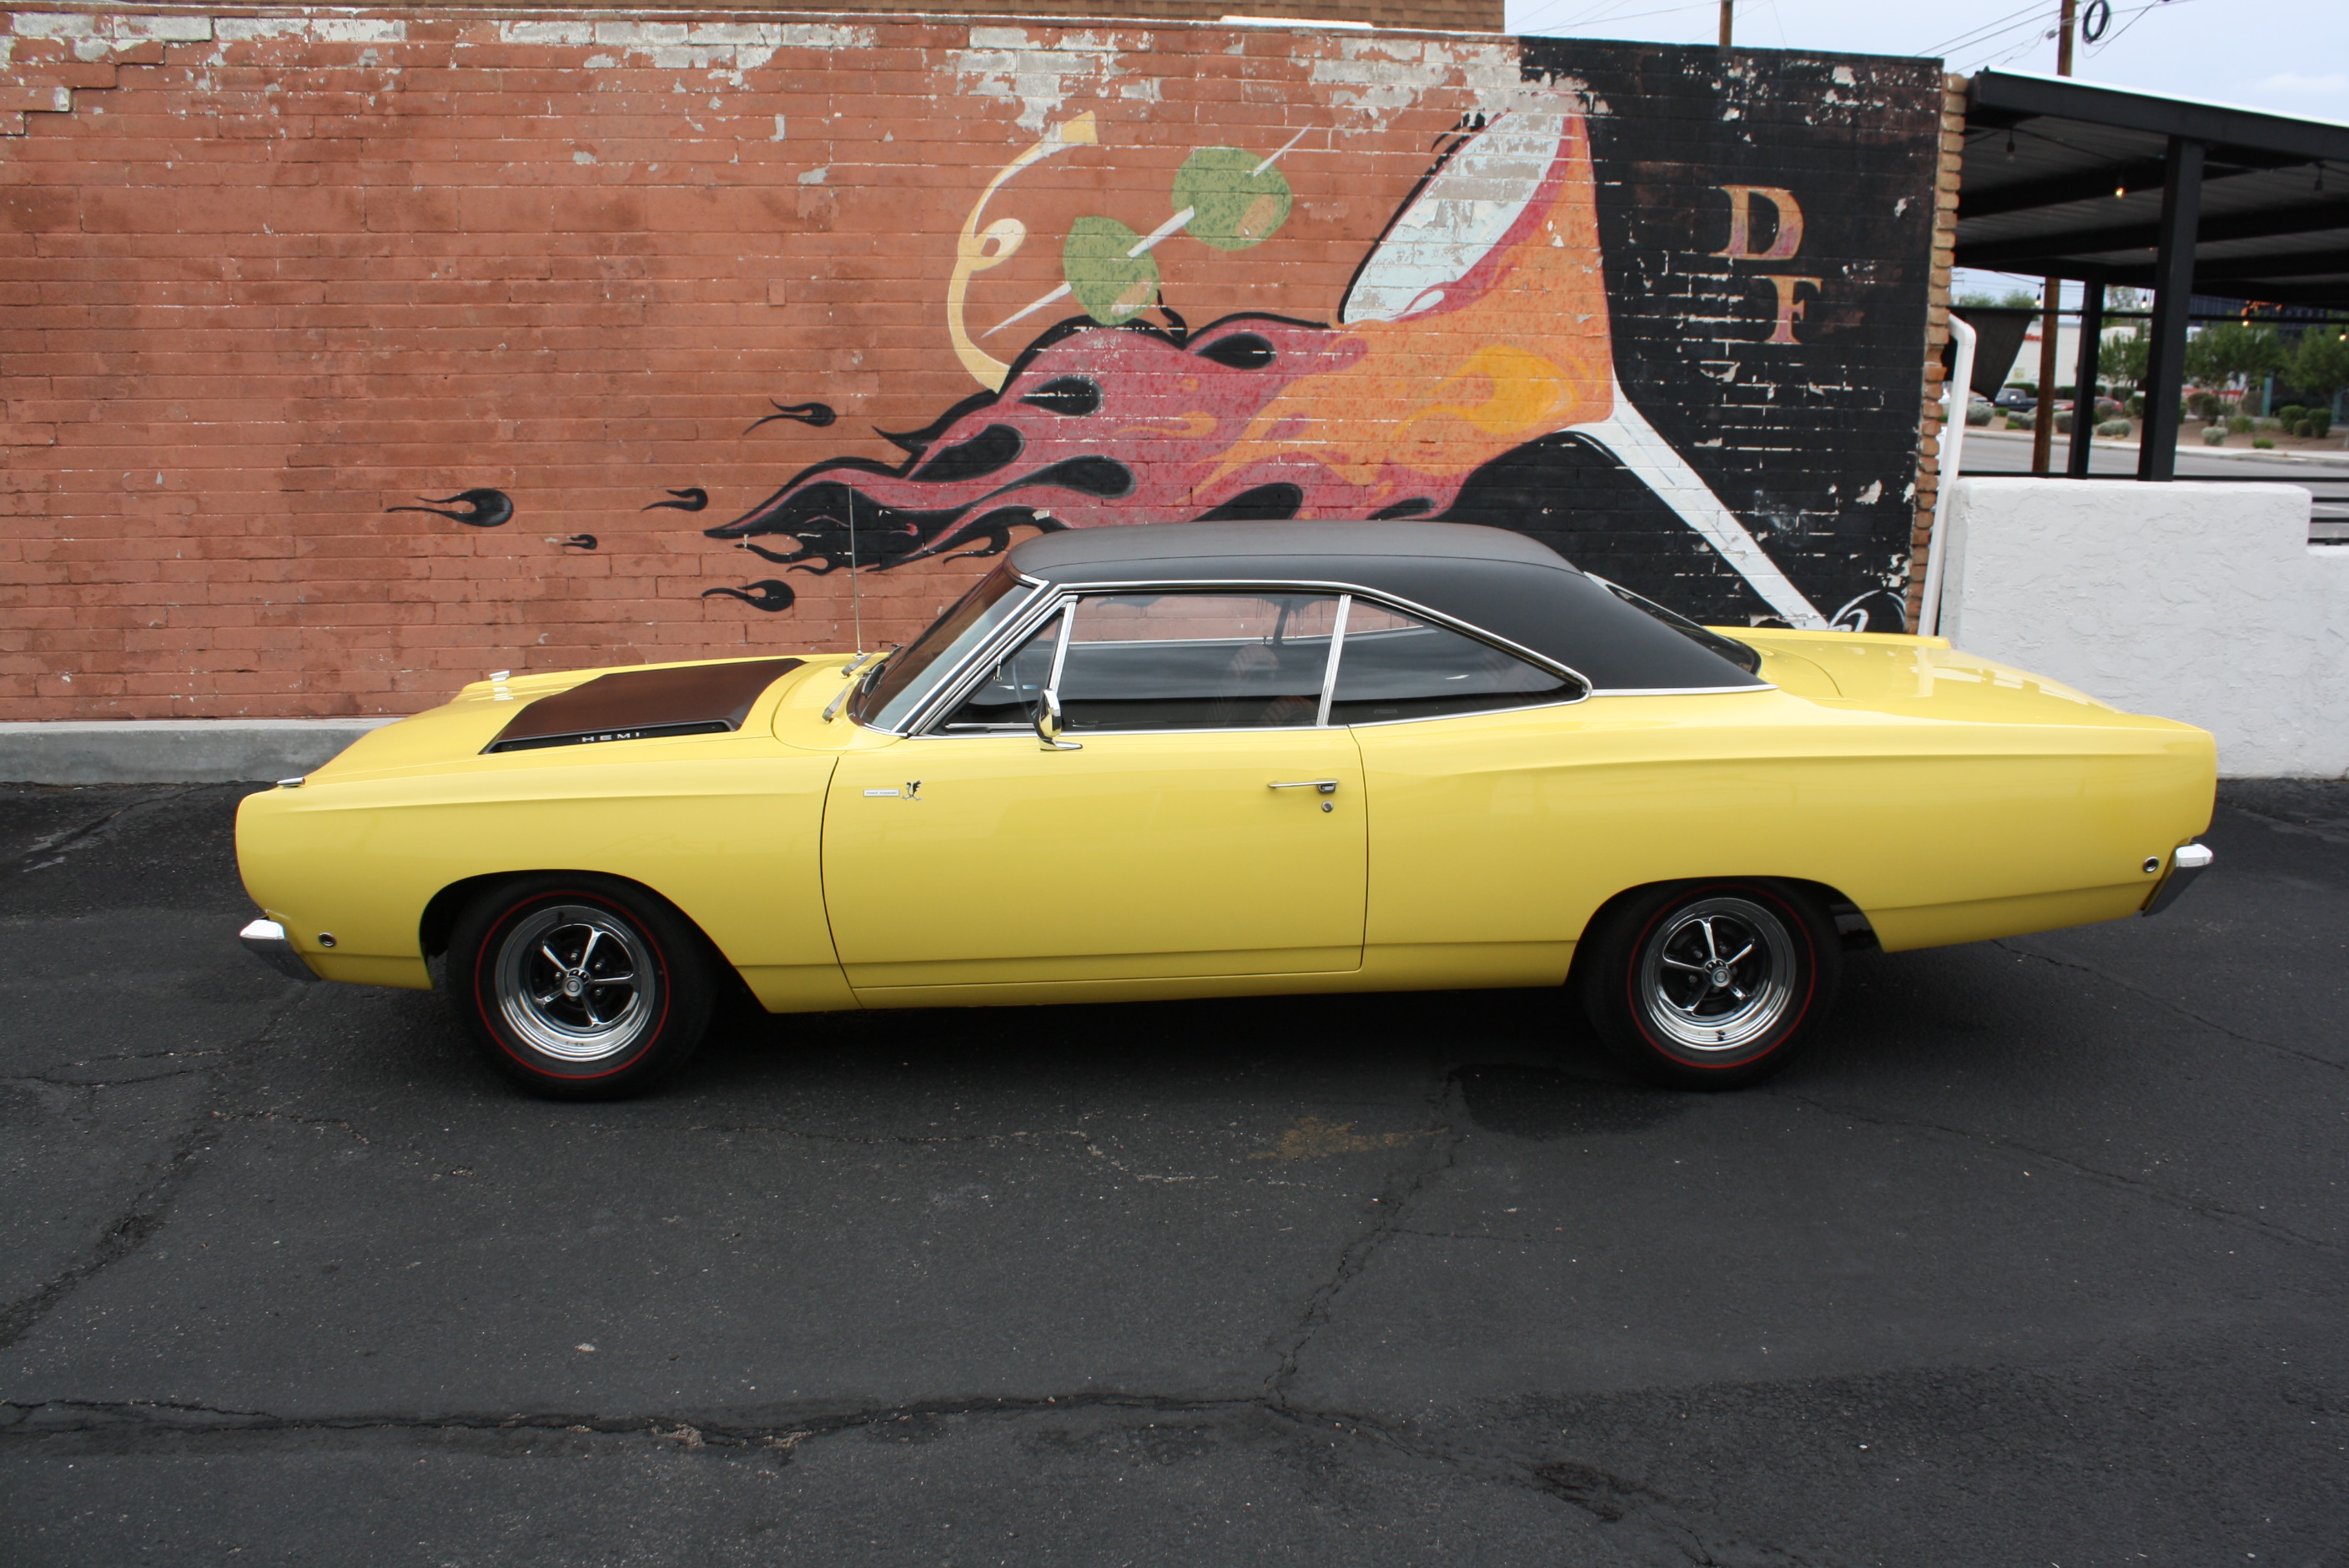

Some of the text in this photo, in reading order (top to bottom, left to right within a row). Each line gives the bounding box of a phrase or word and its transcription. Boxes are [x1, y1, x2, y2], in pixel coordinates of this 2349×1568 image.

[1708, 184, 1804, 260] D
[1763, 274, 1823, 344] F
[581, 731, 640, 742] HEMI
